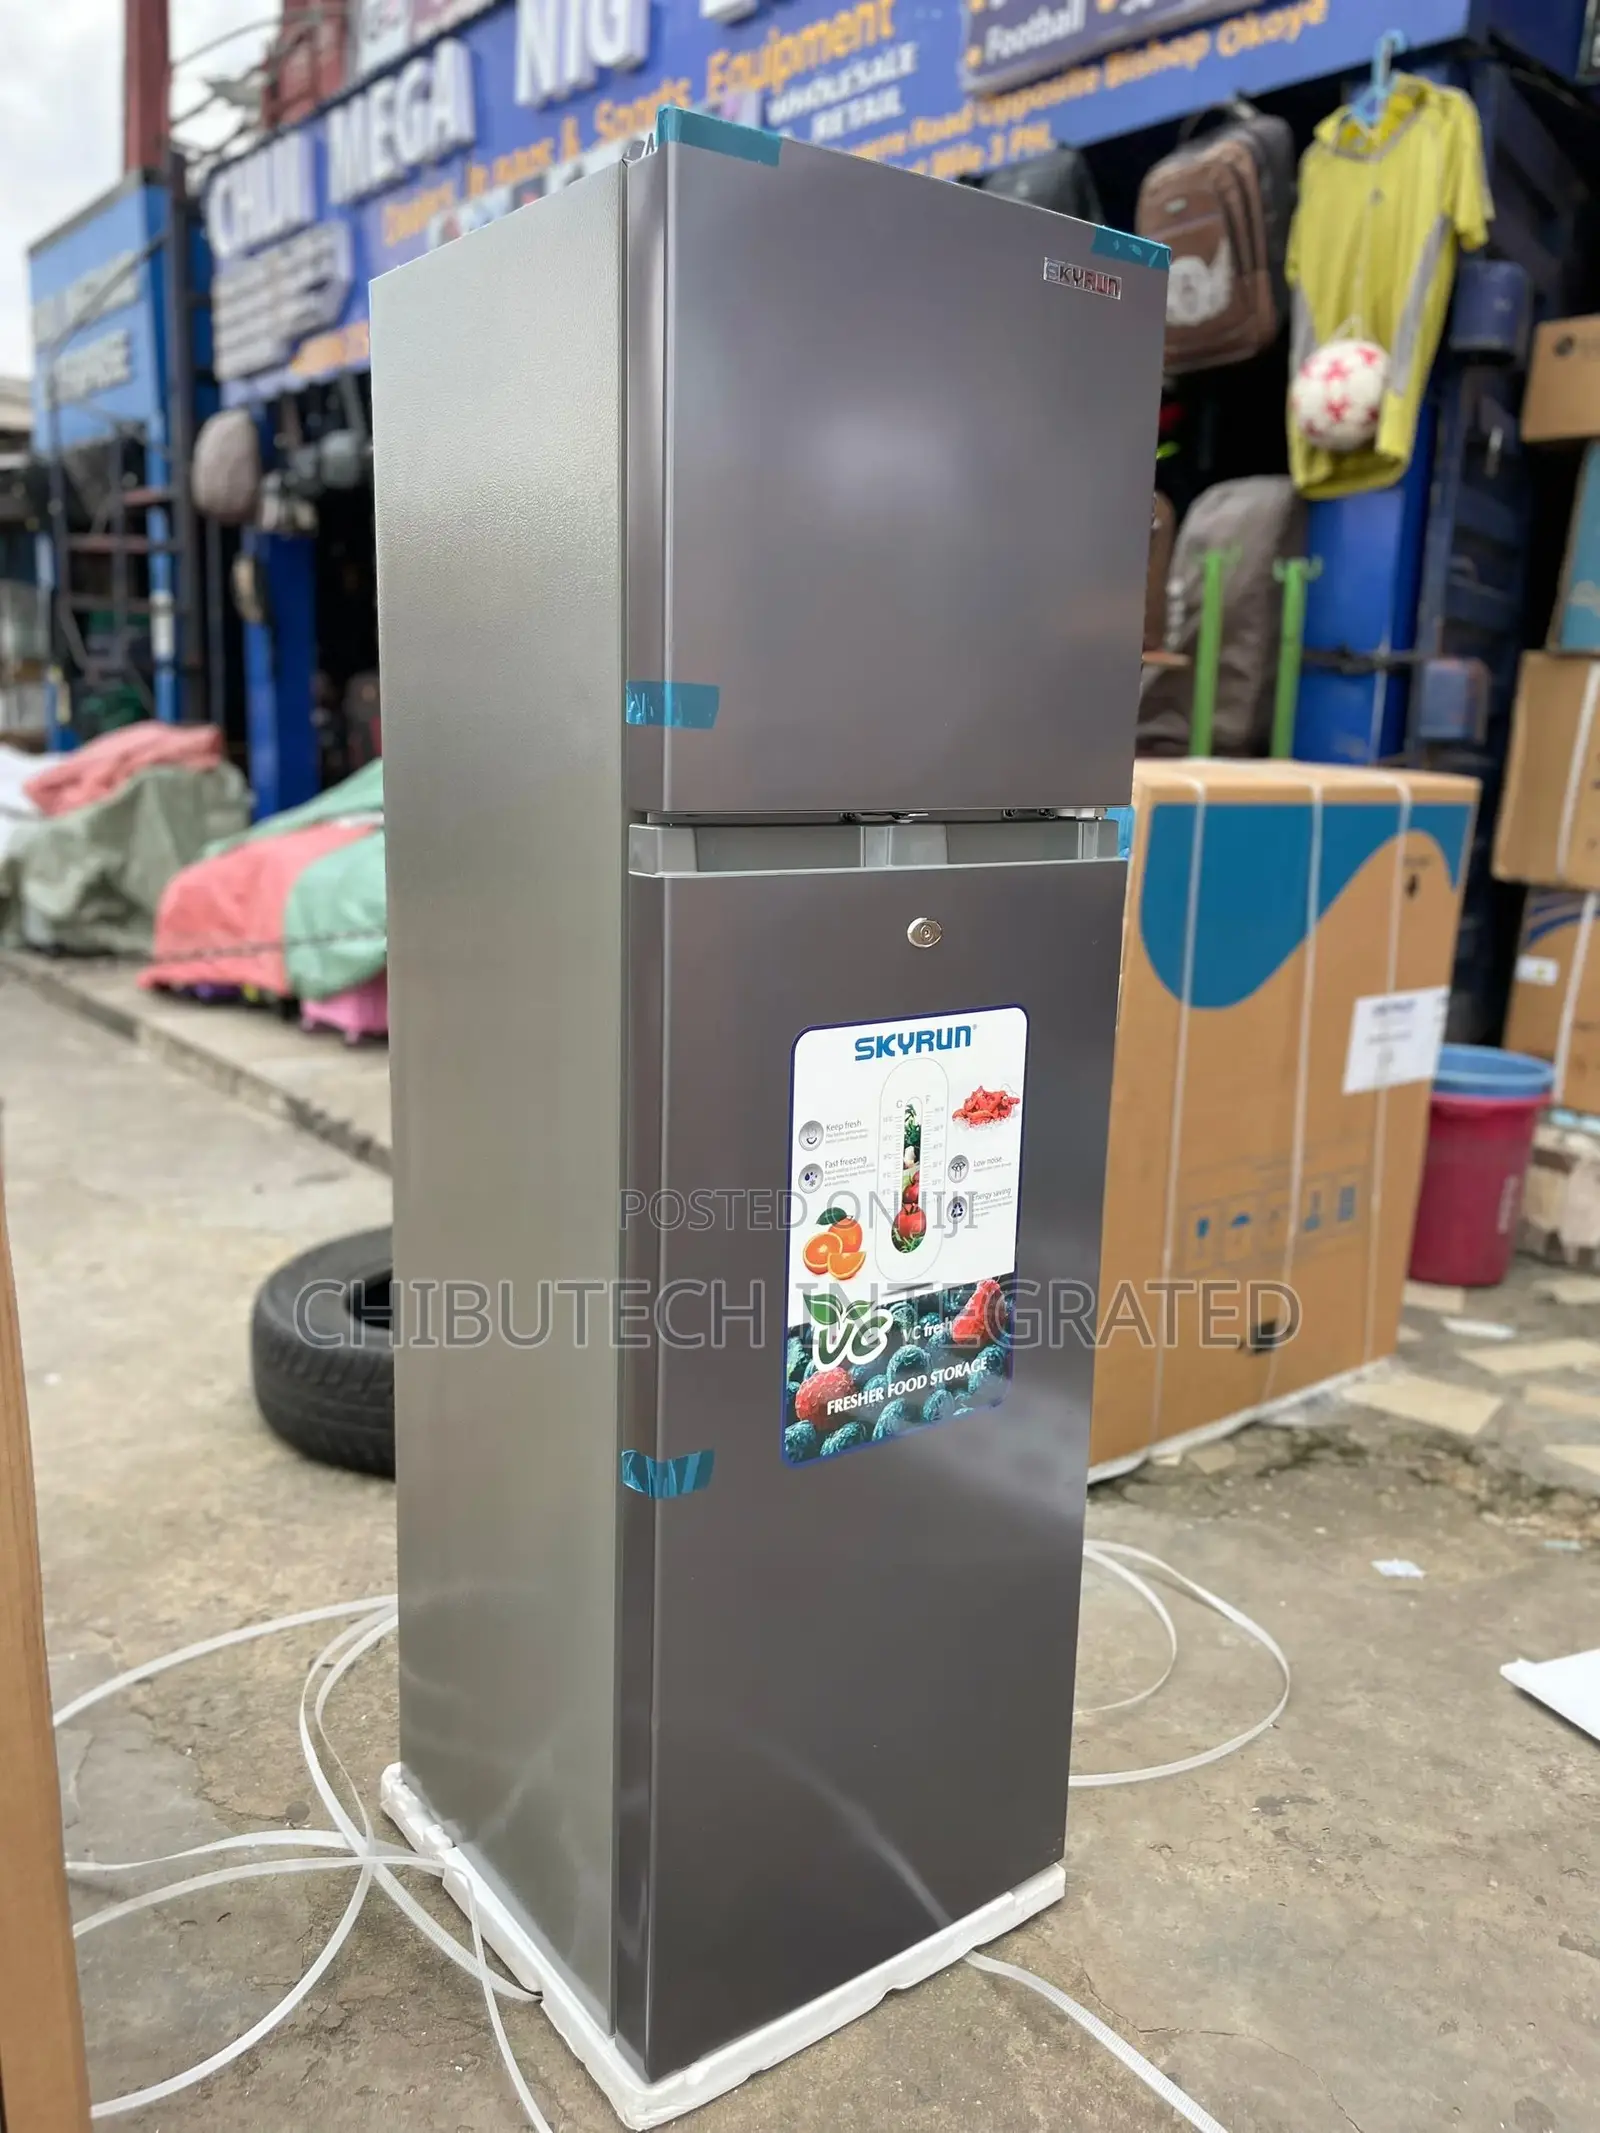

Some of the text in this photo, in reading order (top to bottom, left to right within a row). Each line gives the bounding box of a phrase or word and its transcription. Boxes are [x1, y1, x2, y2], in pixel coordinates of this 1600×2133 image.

[326, 36, 475, 203] MEGA
[1046, 260, 1119, 298] SKYRUN
[855, 1025, 971, 1061] SKYRUN
[826, 1119, 862, 1132] Keep fresh
[825, 1156, 867, 1169] Fast freezing
[973, 1159, 985, 1167] Low
[903, 1325, 921, 1342] VC
[826, 1357, 988, 1416] FRESHER FOOD STORAGE
